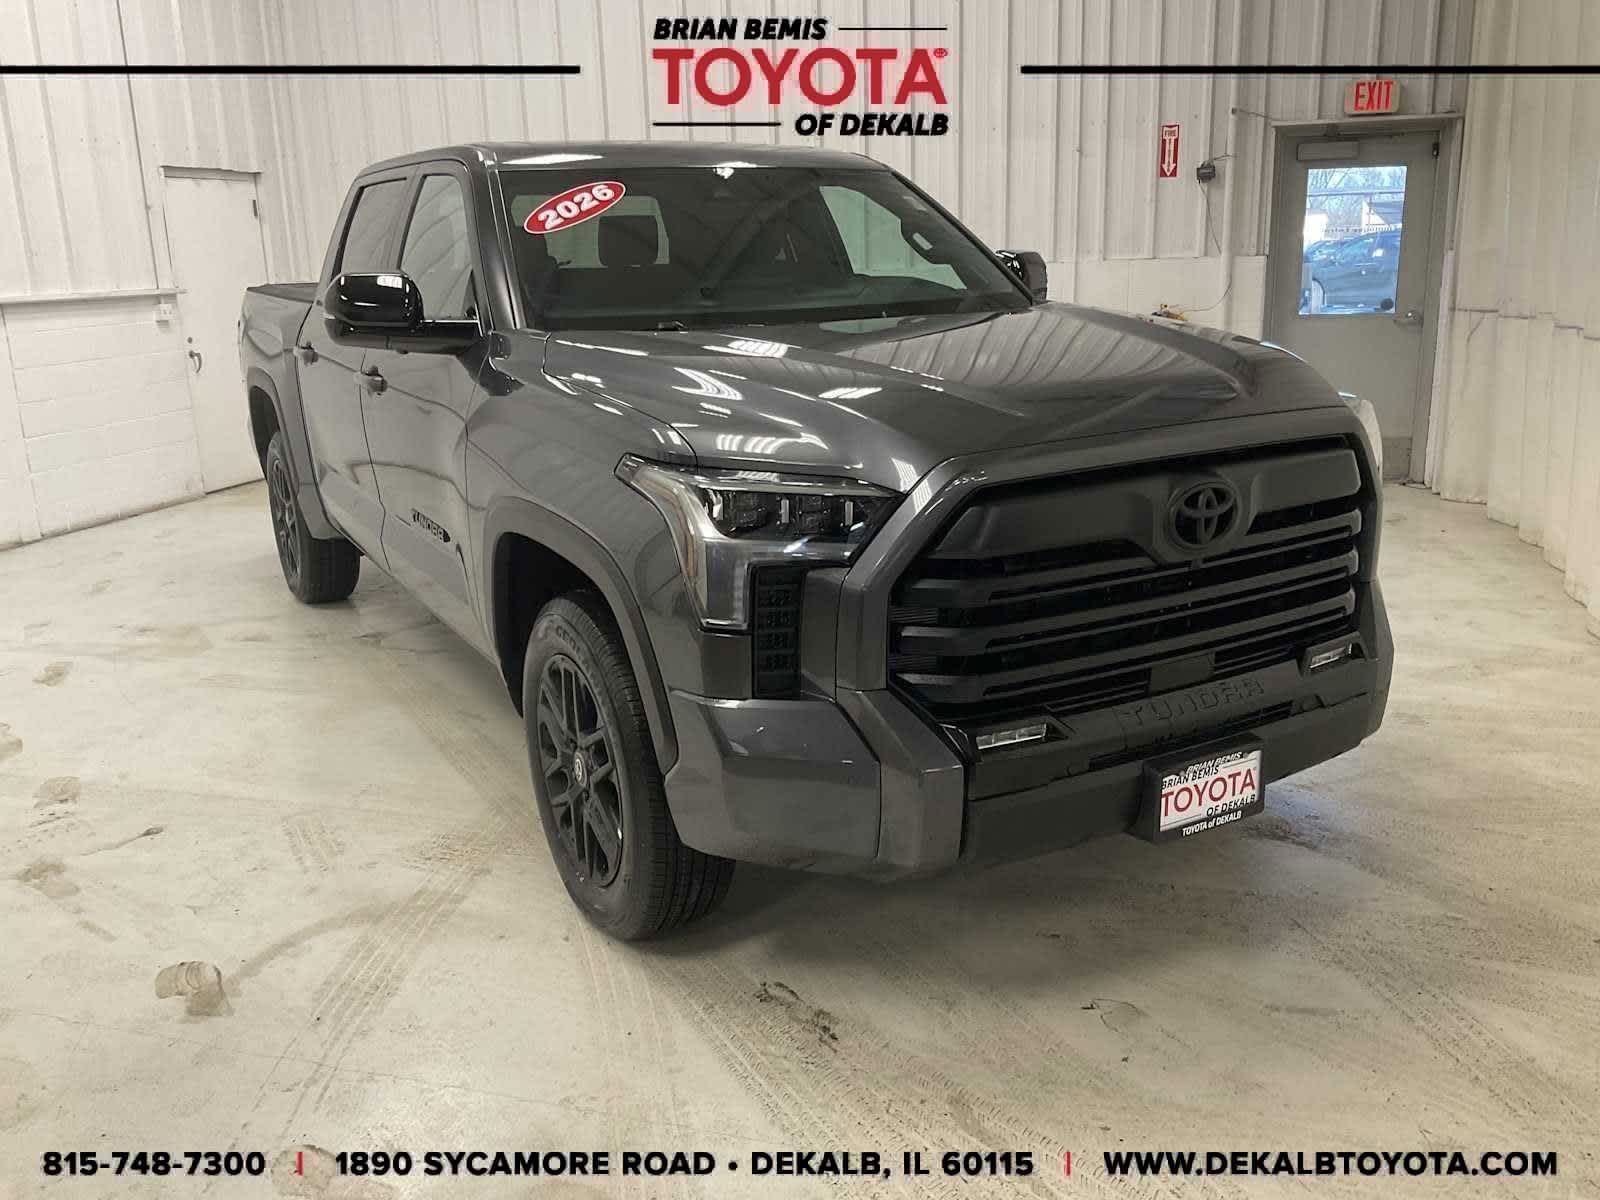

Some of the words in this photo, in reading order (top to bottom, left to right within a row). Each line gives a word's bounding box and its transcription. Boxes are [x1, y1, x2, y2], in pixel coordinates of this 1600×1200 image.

[1353, 80, 1394, 112] EXIT
[537, 184, 615, 230] 2026
[1191, 766, 1219, 780] BEMIS
[1161, 768, 1256, 817] TOYOTA
[1206, 806, 1219, 817] OF
[1221, 794, 1256, 812] DEKALB
[1182, 820, 1207, 837] TOYOTA
[1216, 810, 1242, 826] DEKALB
